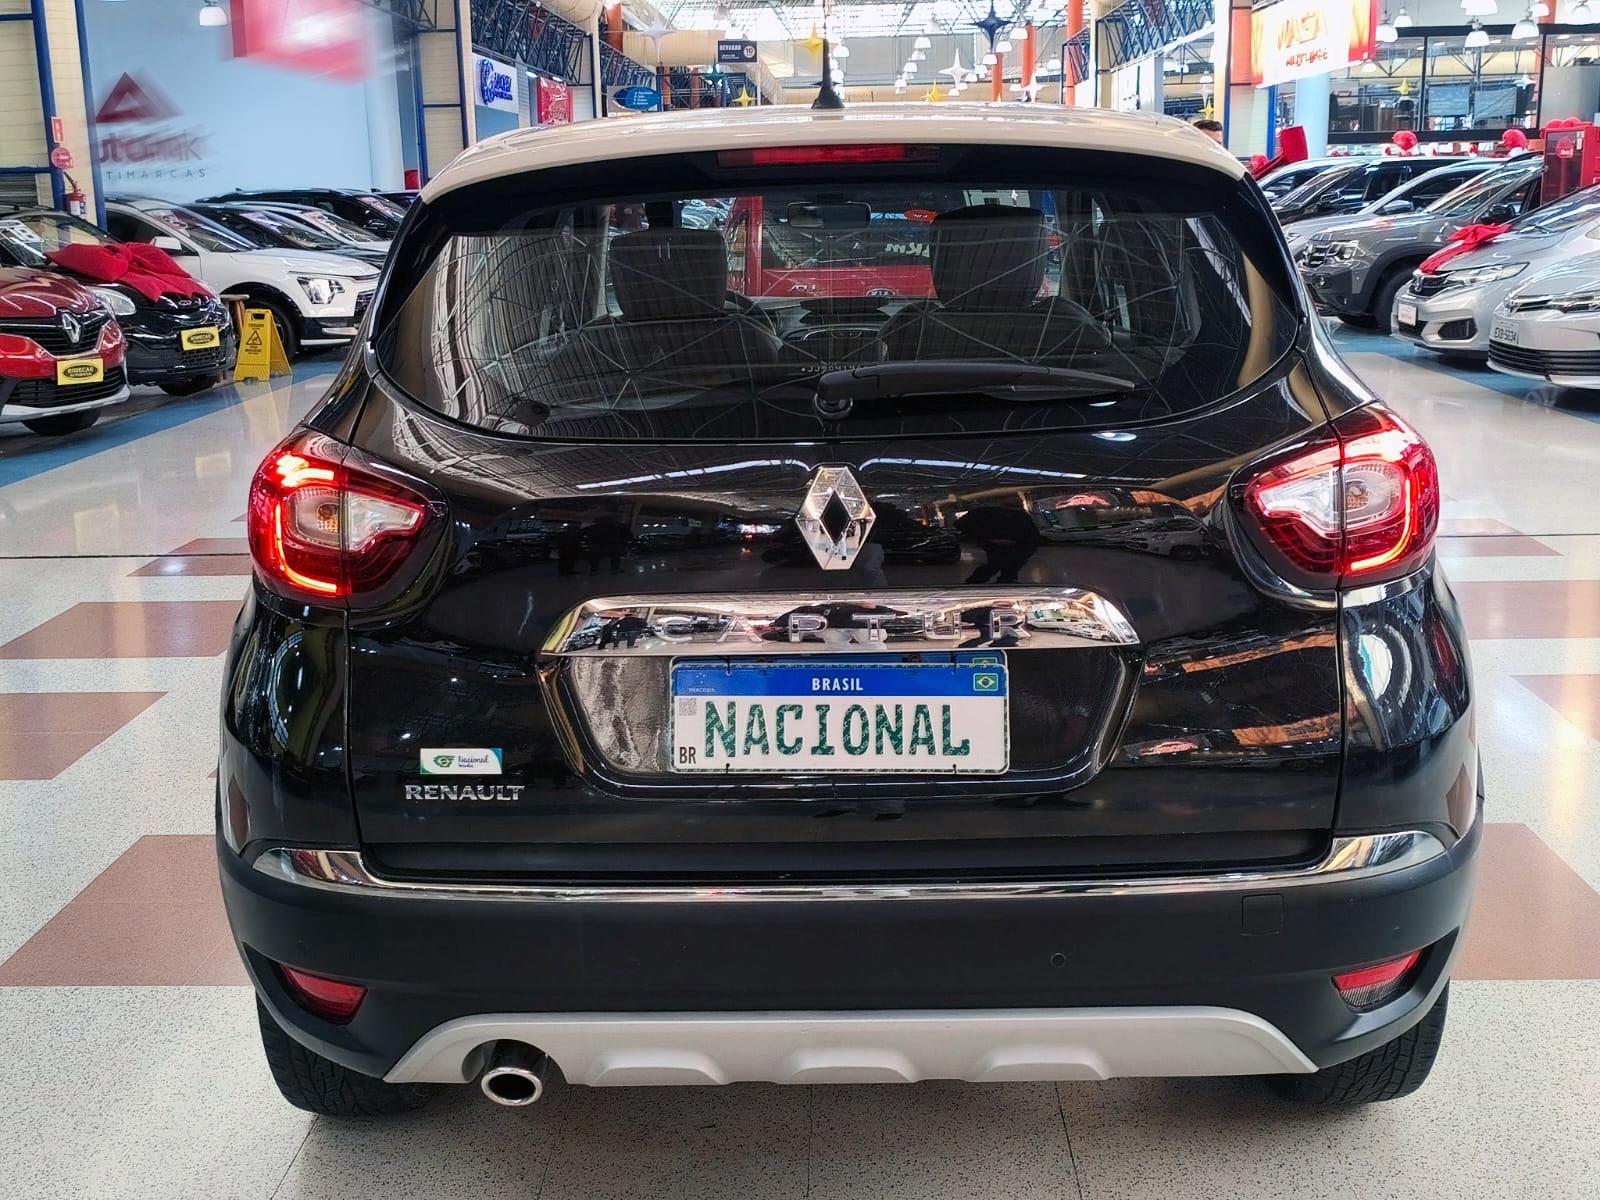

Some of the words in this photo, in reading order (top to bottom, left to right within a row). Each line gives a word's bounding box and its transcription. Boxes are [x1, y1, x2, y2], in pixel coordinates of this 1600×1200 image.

[655, 613, 1030, 642] CAPTUR
[811, 677, 865, 692] BRASIL
[704, 700, 971, 758] NACIONAL
[679, 746, 697, 765] BR
[404, 784, 526, 801] RENAULT
